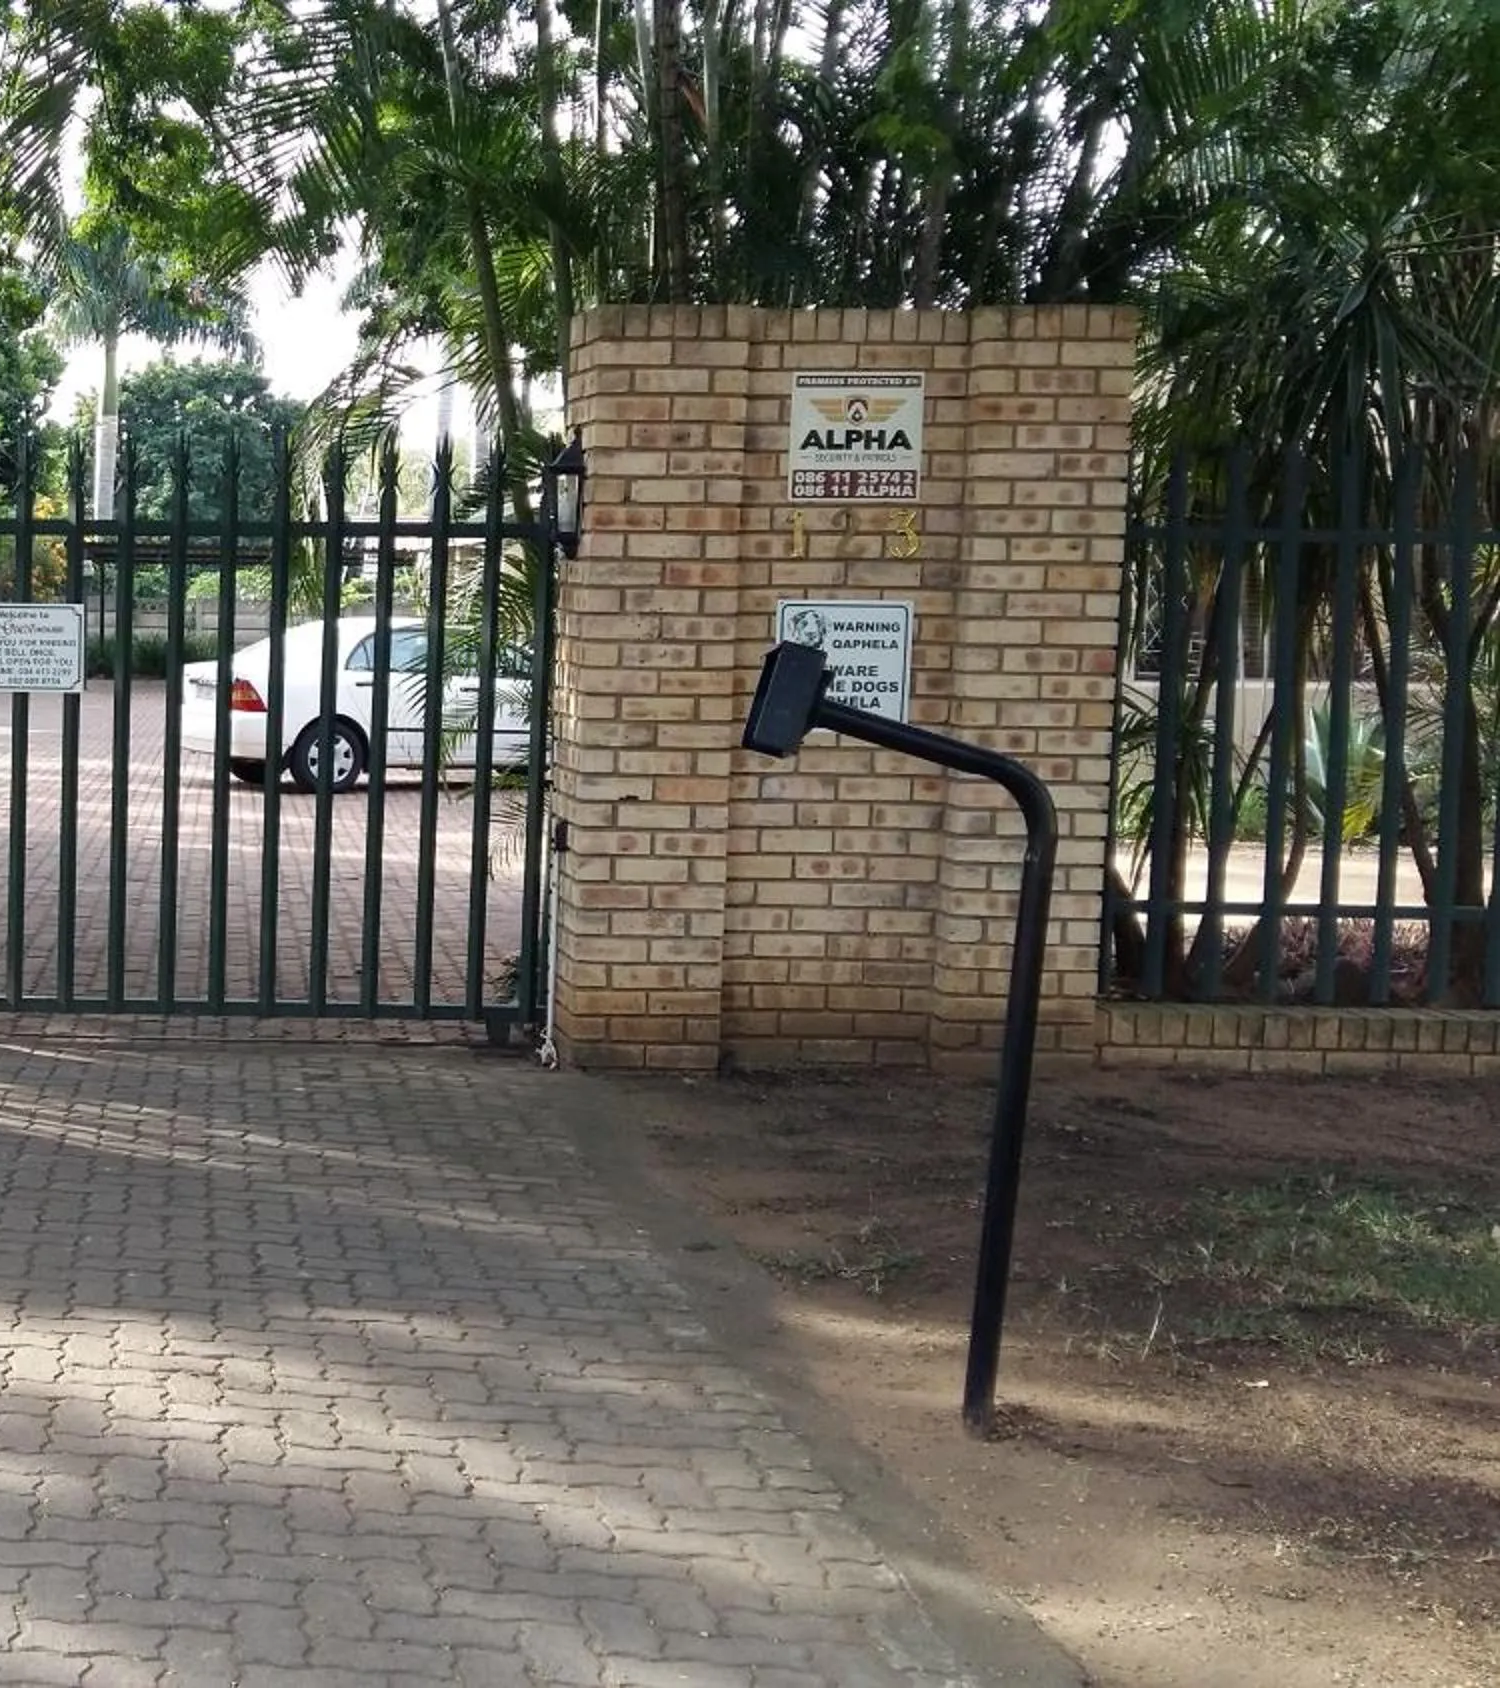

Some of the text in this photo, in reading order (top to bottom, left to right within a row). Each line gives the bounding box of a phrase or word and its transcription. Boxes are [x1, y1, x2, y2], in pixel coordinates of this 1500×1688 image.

[800, 429, 913, 451] ALPHA
[795, 471, 914, 484] 086 11 25742
[794, 485, 914, 497] 086 11 ALPHA
[832, 621, 901, 633] WARNING
[0, 639, 17, 647] YOU
[19, 639, 36, 647] FOR
[832, 640, 899, 650] QAPHELA
[4, 648, 25, 656] BELL
[5, 658, 31, 666] OPEN
[33, 658, 51, 666] FOR
[829, 665, 879, 677] WARE
[852, 681, 899, 693] DOGS
